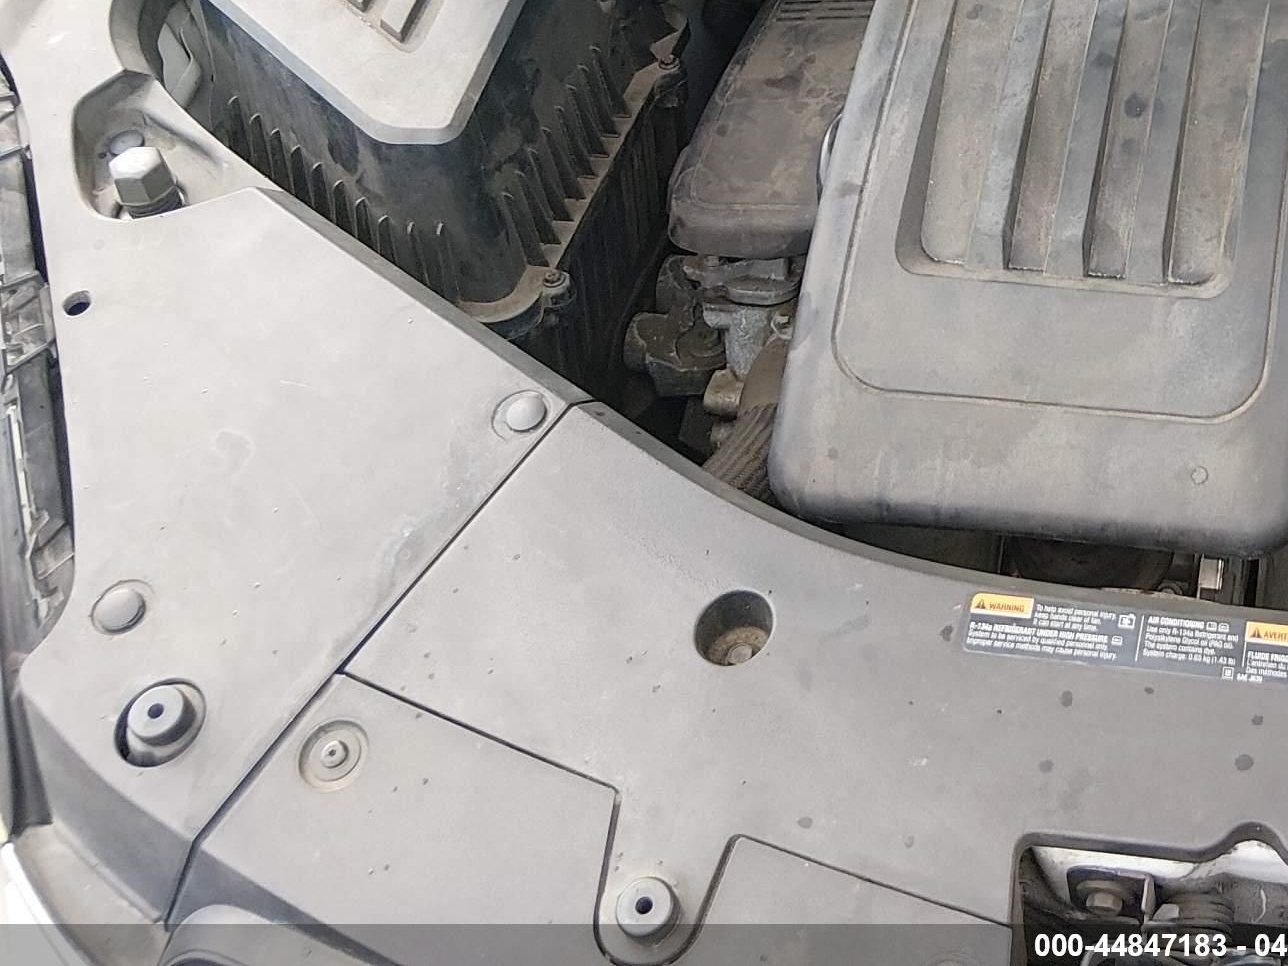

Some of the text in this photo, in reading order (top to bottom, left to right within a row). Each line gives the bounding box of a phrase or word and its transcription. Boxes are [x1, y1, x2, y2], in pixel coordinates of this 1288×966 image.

[989, 601, 1024, 612] WARNING
[1044, 604, 1056, 613] help
[1057, 606, 1073, 614] avoid
[1074, 607, 1098, 618] personal
[1034, 611, 1048, 619] keep
[1050, 612, 1068, 621] hands
[1068, 614, 1083, 622] clear
[1148, 615, 1204, 629] AIR CONDITIONING
[1038, 618, 1048, 626] can
[1050, 619, 1064, 628] start
[1072, 622, 1082, 631] any
[1083, 623, 1097, 631] time.
[969, 621, 1107, 643] R-134a REFRIGERANT UNDER HIGH PRESSURE
[1146, 625, 1238, 641] Use only R-134a Refrigerant and
[968, 629, 990, 638] System
[1006, 633, 1031, 642] serviced
[1032, 636, 1040, 644] by
[1040, 637, 1064, 646] qualified
[1065, 639, 1094, 649] personnel
[1181, 636, 1199, 646] Glycol
[1208, 639, 1222, 648] (PAG
[966, 636, 993, 646] Improper
[993, 639, 1014, 648] service
[1015, 641, 1040, 651] methods
[1041, 644, 1055, 654] may
[1055, 645, 1073, 654] cause
[1073, 647, 1099, 658] personal
[1145, 640, 1155, 648] The
[1156, 642, 1177, 651] system
[1178, 643, 1202, 653] contains
[1142, 648, 1164, 658] System
[1202, 654, 1210, 663] kg
[1211, 655, 1226, 664] (1.43
[1248, 650, 1269, 660] FLUIDE
[1246, 666, 1258, 674] Des
[1258, 667, 1286, 677] méthodes
